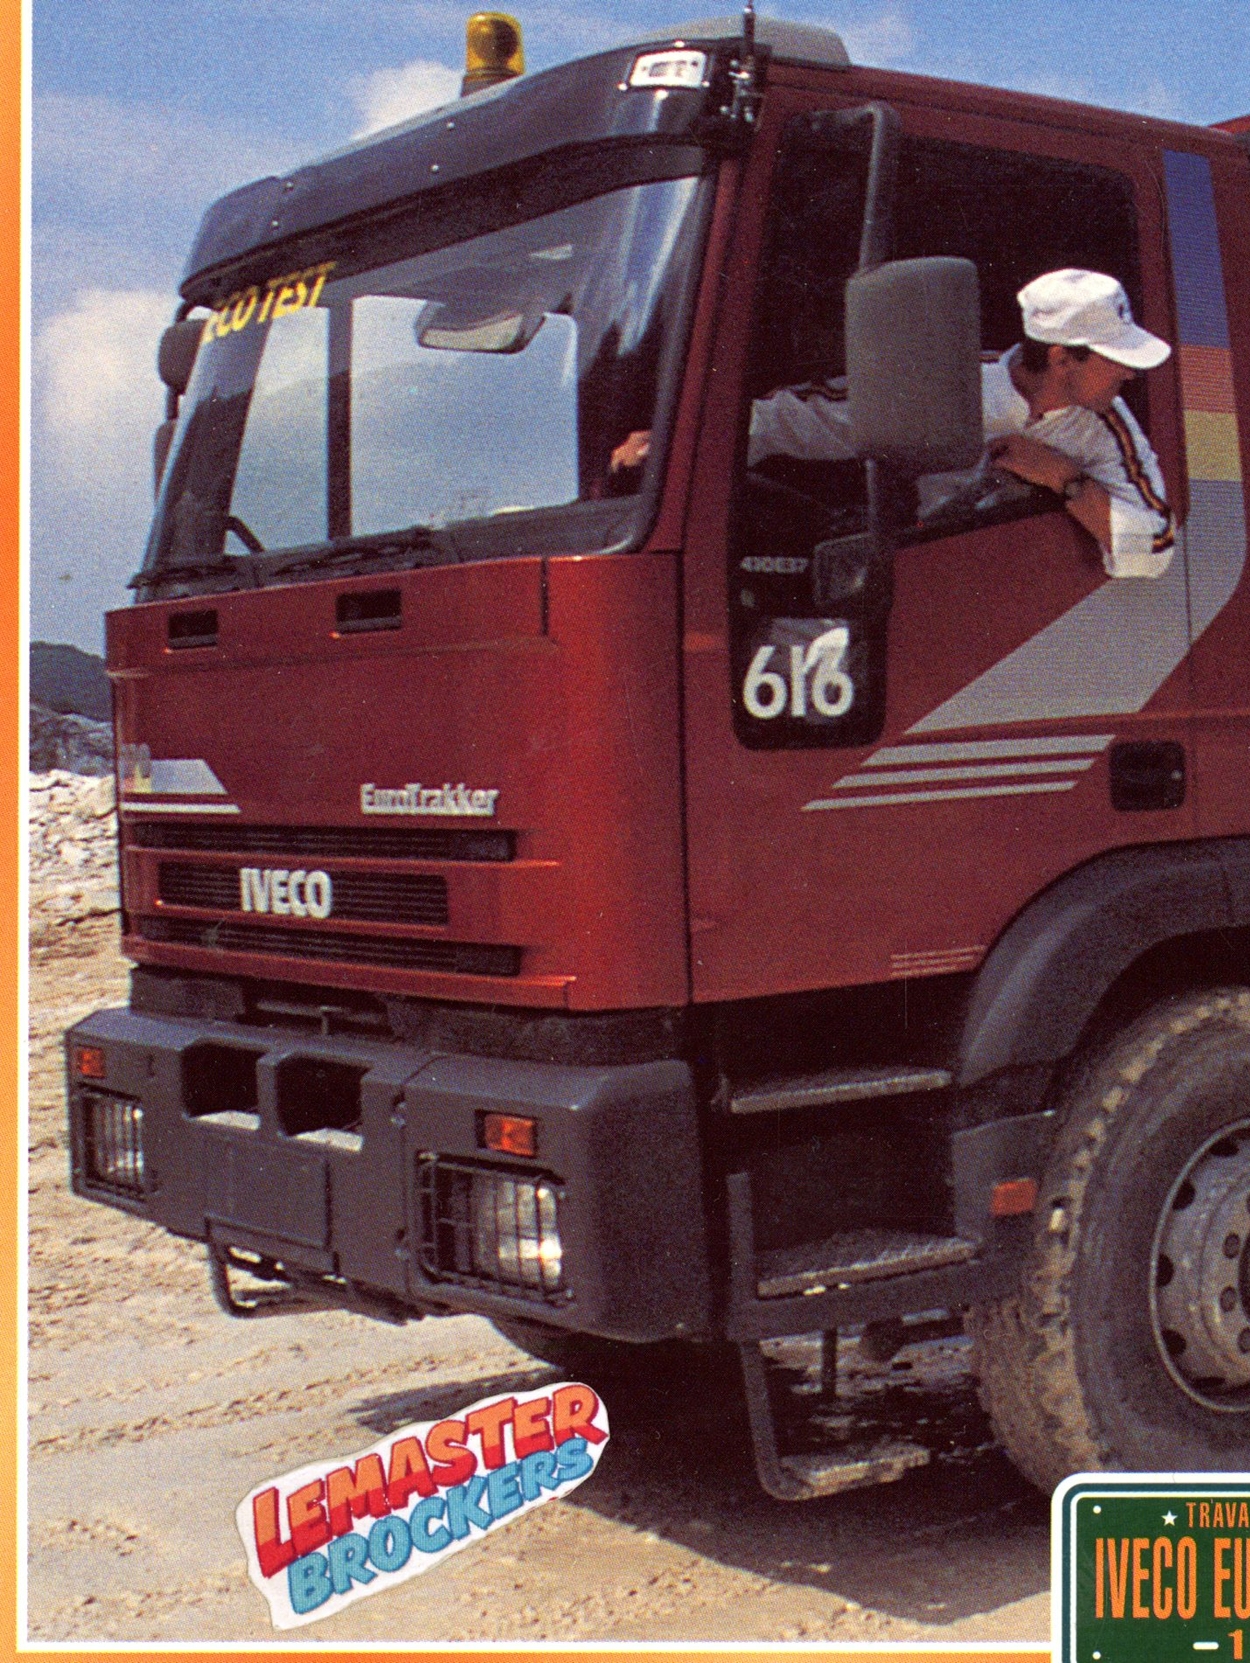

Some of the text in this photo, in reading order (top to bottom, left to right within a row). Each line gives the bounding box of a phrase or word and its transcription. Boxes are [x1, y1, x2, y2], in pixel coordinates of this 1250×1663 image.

[257, 261, 338, 322] TEST
[360, 783, 500, 817] EuroTrakker
[239, 866, 333, 920] IVECO
